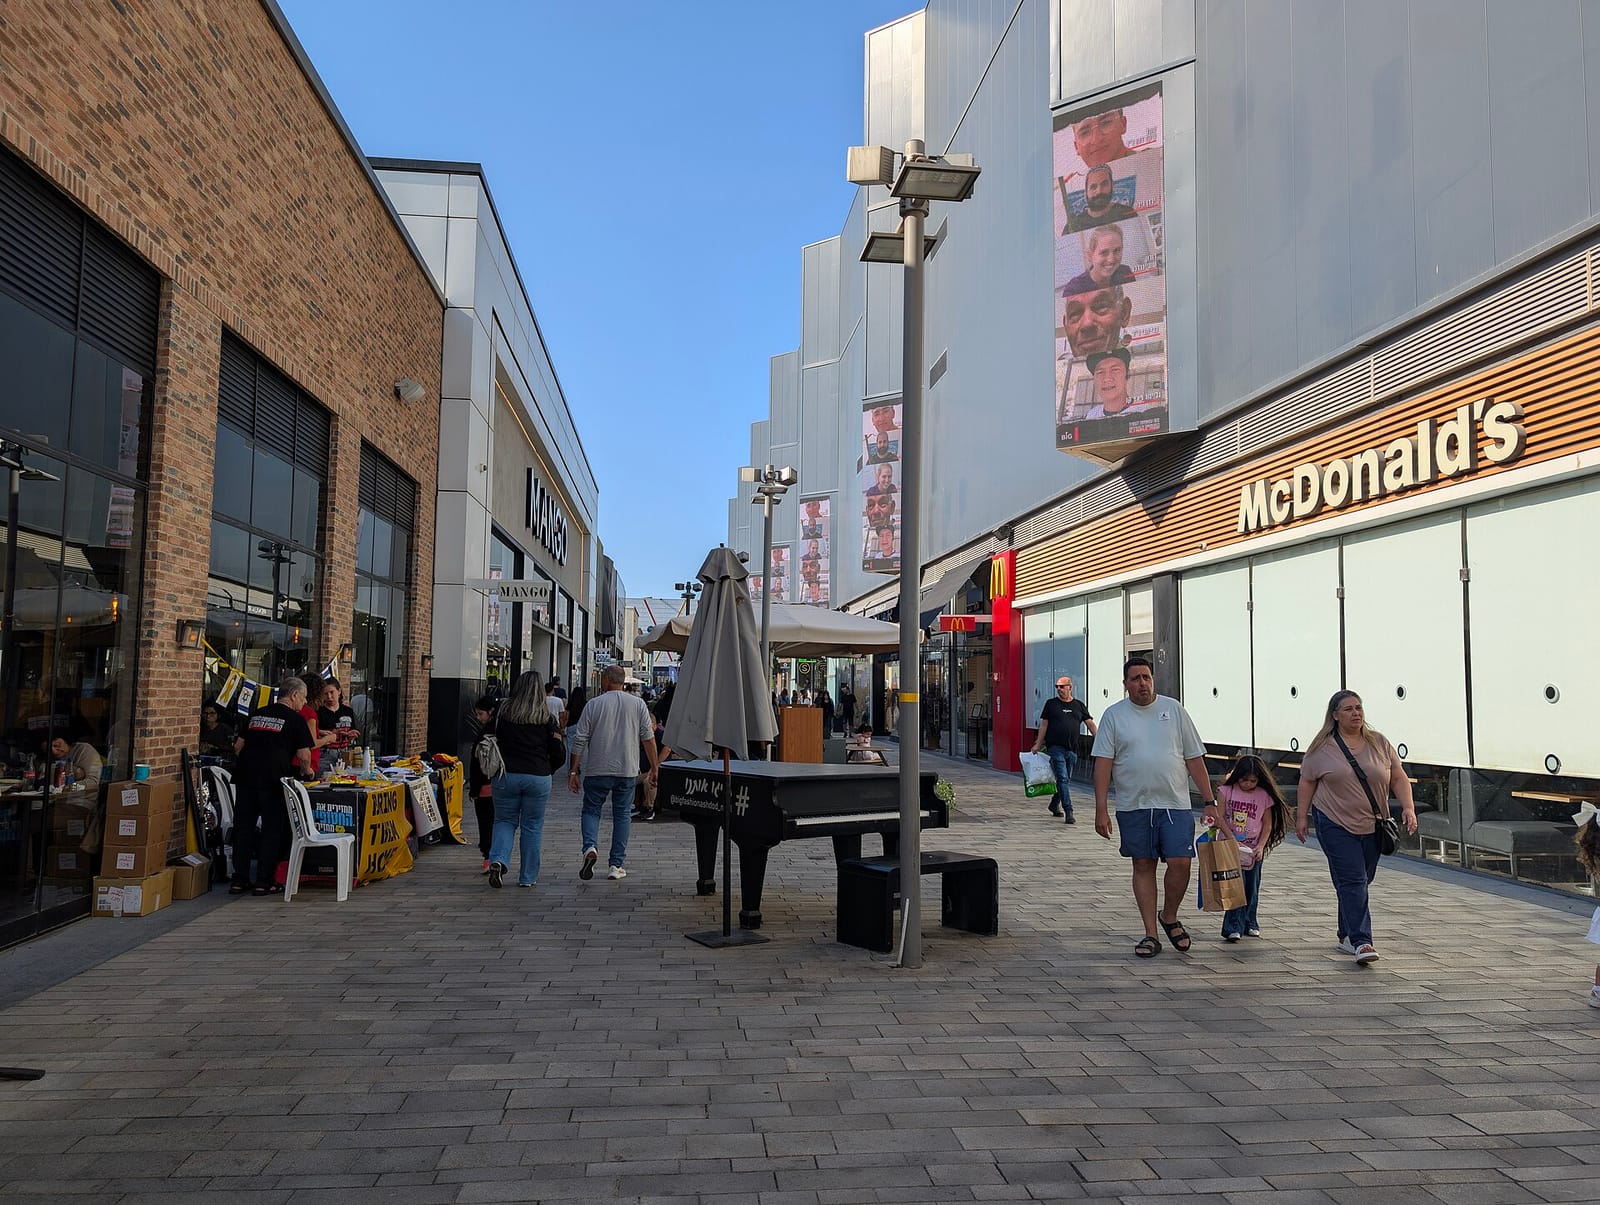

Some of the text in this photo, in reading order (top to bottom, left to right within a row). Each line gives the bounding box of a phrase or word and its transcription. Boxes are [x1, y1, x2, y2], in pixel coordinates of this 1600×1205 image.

[1237, 398, 1526, 533] McDonald's
[525, 467, 569, 567] MANGO
[500, 582, 549, 598] MANGO
[312, 809, 354, 827] החטופי
